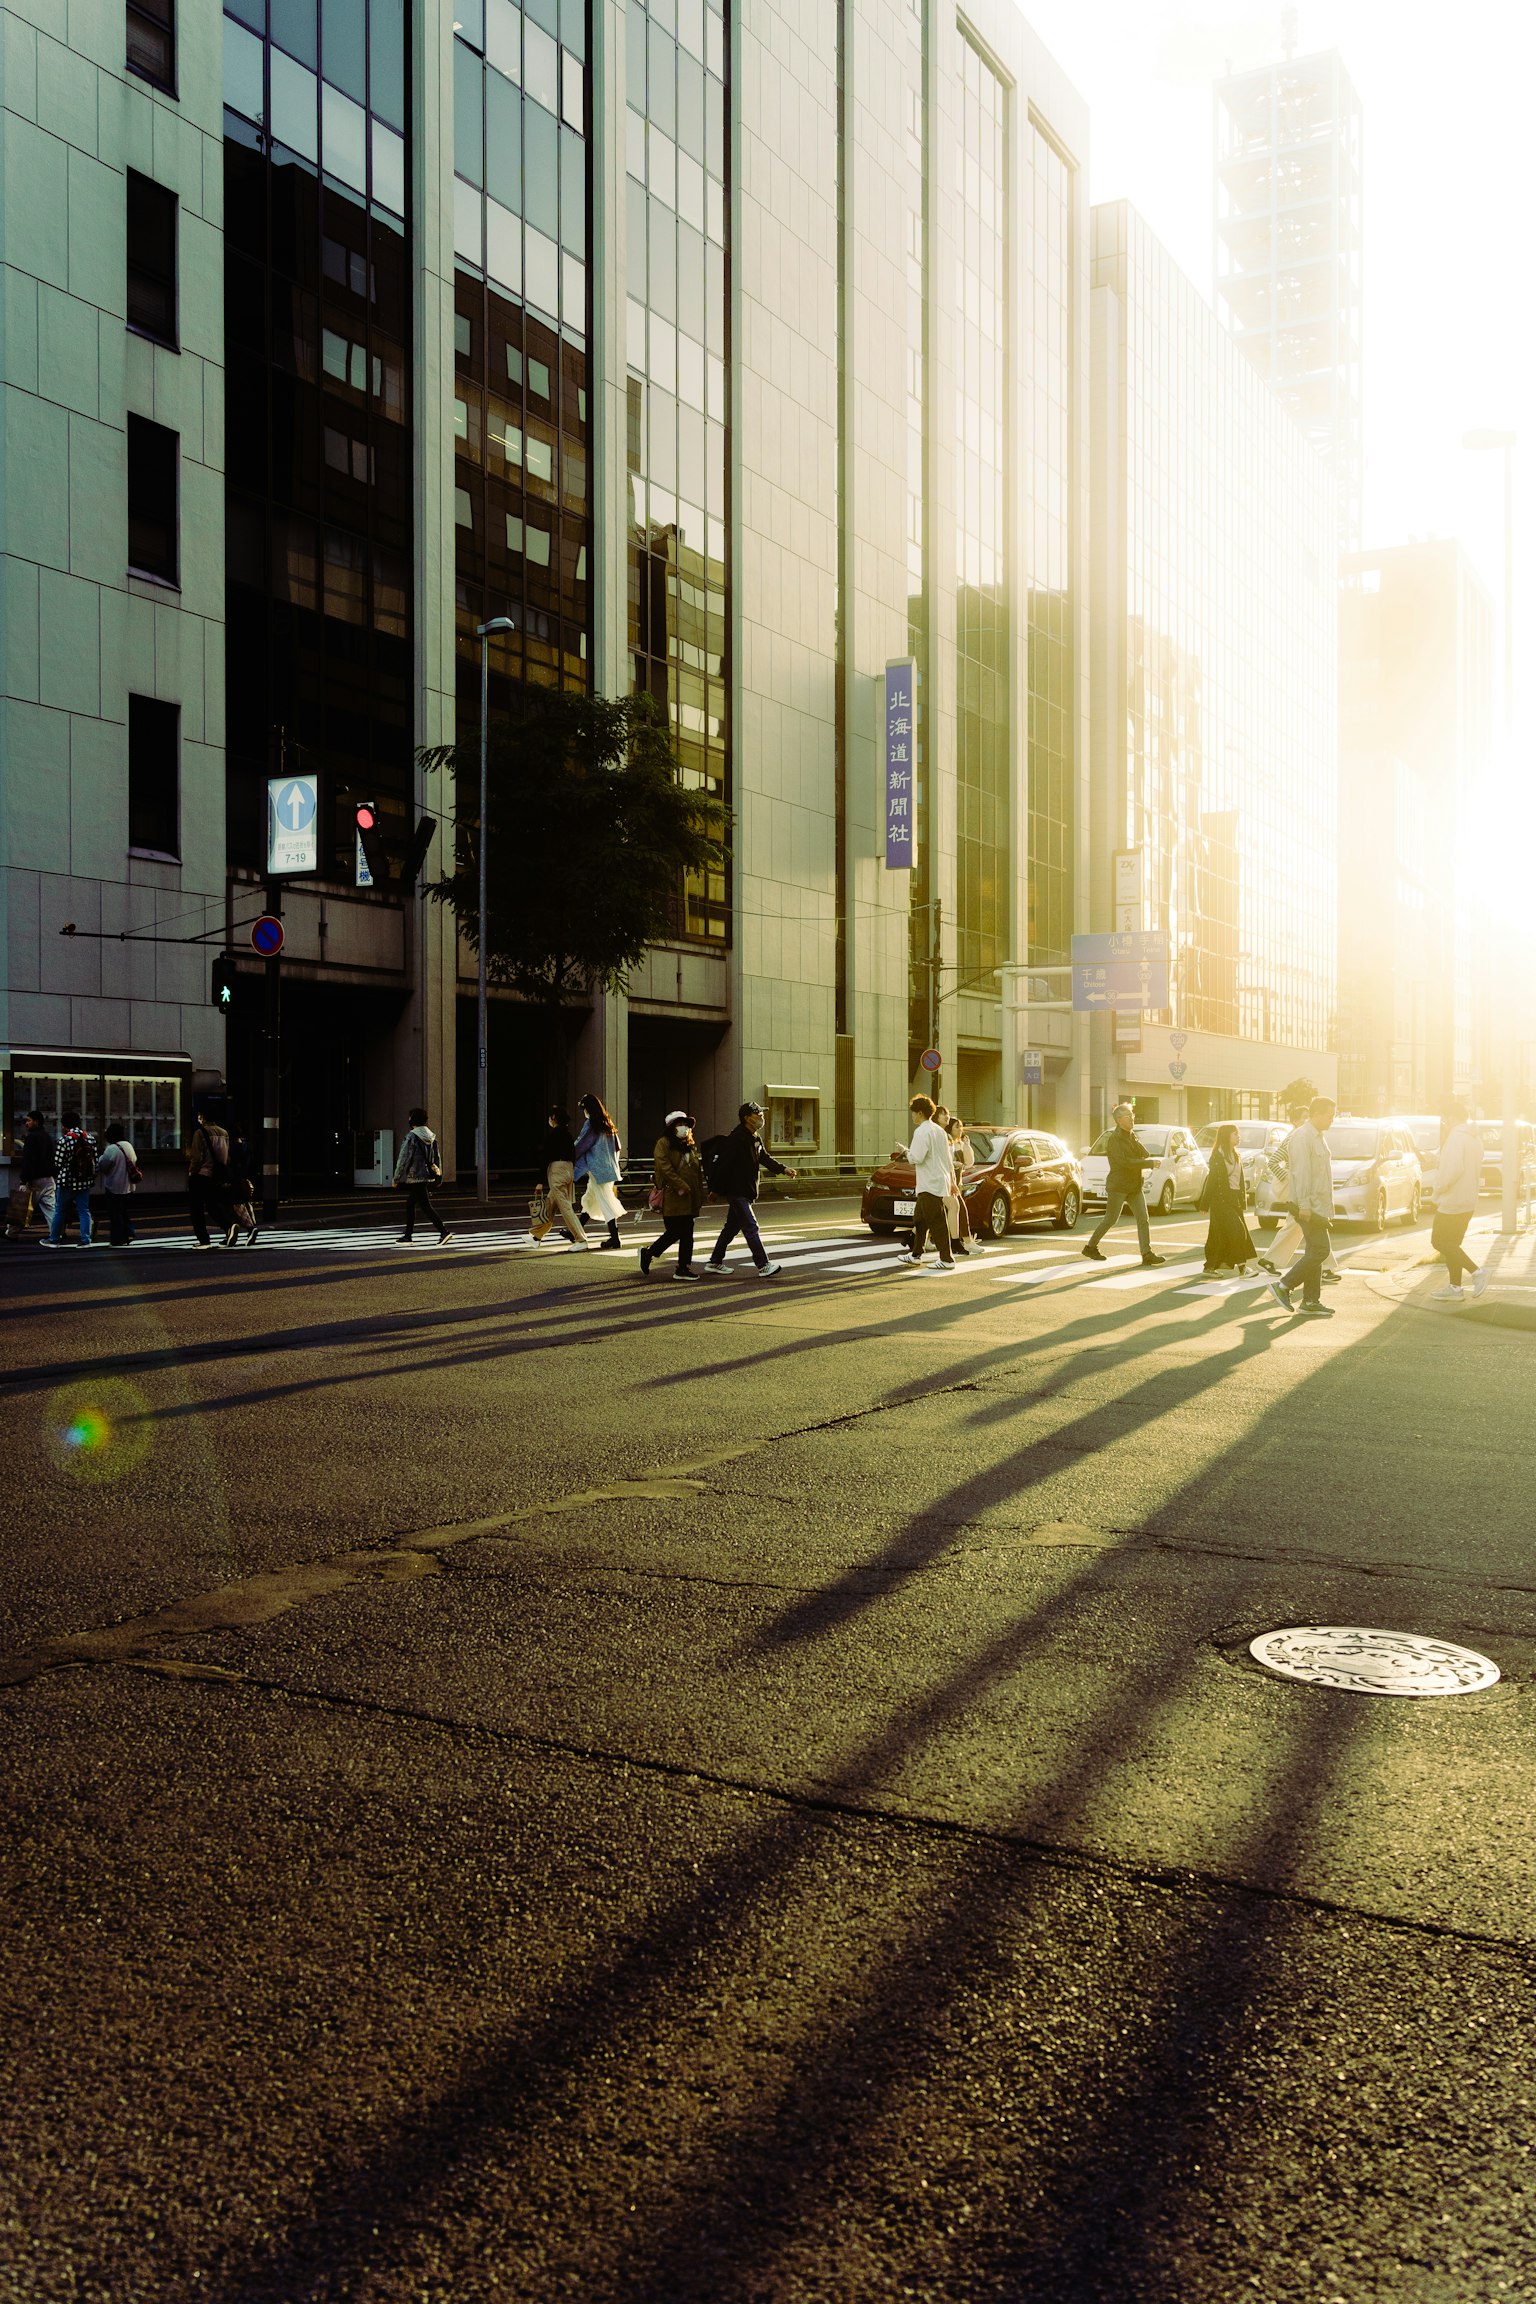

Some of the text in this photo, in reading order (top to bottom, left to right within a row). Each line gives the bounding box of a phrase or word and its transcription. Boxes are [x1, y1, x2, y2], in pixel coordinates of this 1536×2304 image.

[888, 691, 912, 843] 北海道新聞社
[285, 853, 306, 864] 7-19
[1108, 935, 1132, 947] 小樽
[1081, 968, 1106, 980] 千歳
